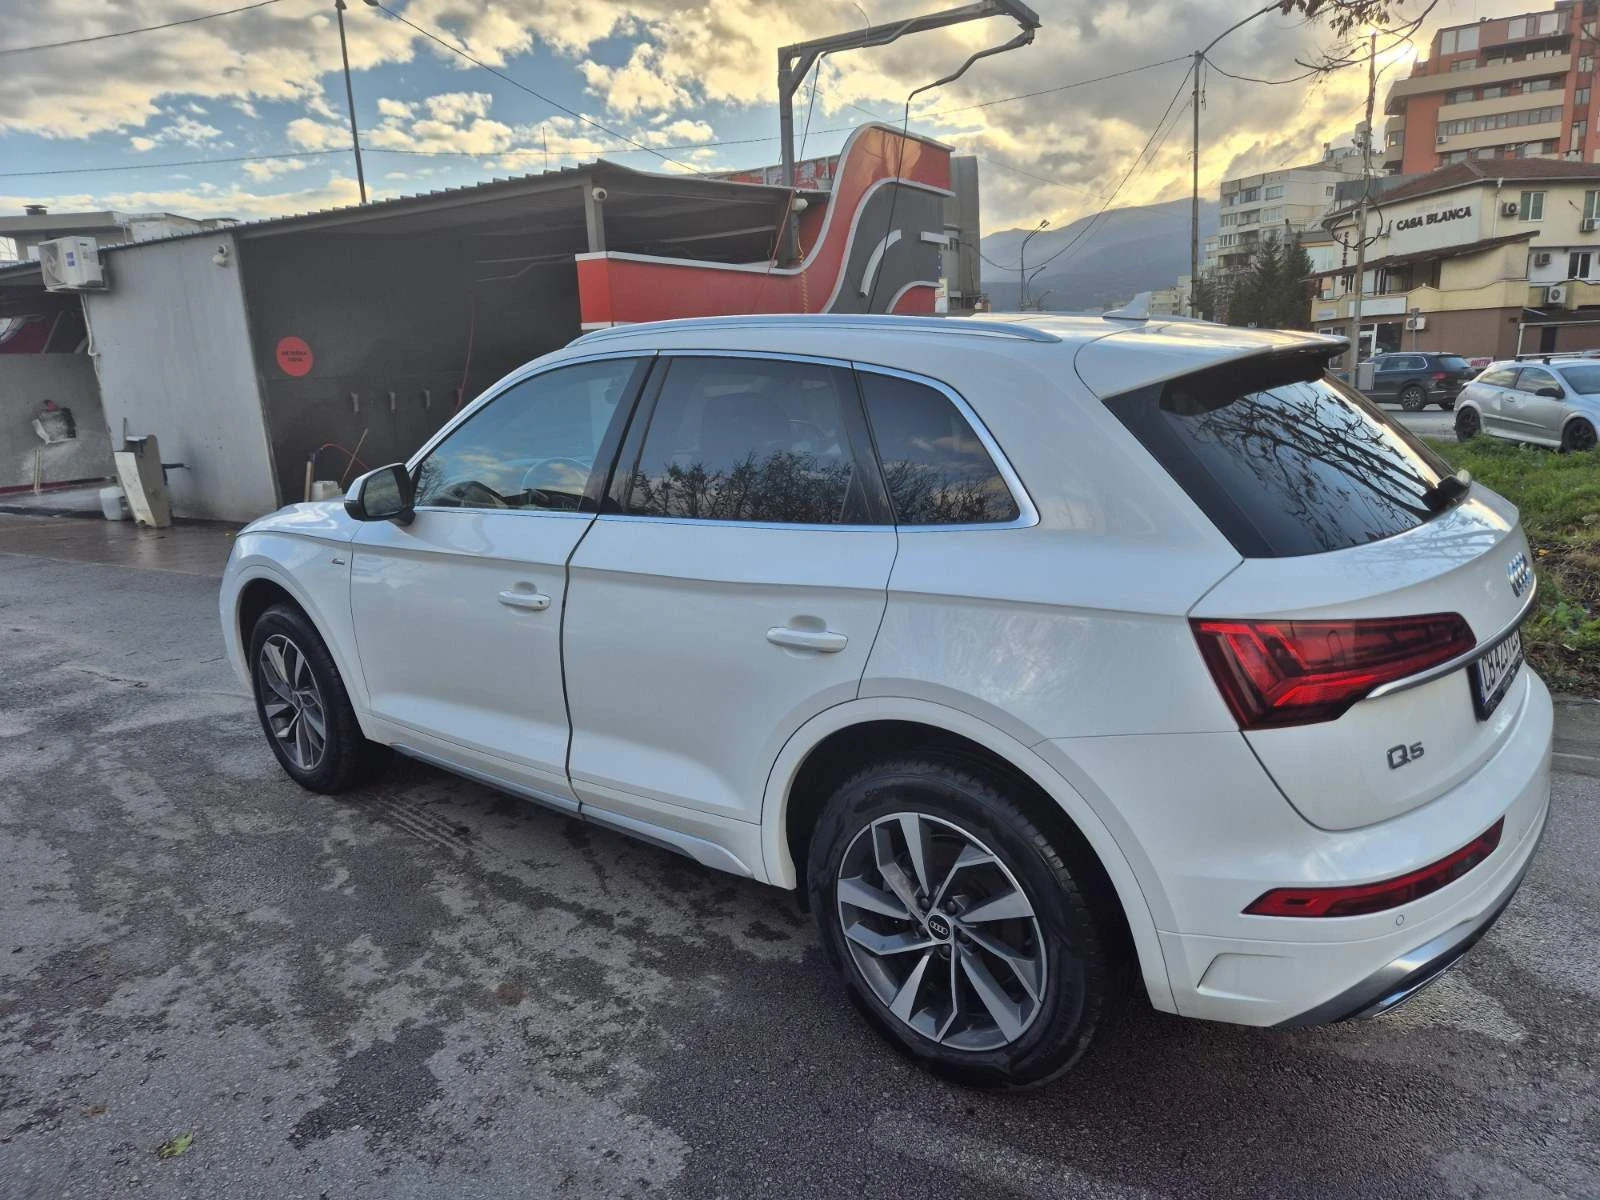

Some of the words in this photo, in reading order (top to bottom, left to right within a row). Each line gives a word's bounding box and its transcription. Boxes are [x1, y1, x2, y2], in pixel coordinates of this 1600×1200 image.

[1397, 216, 1423, 231] CASA
[1426, 206, 1472, 225] BLANCA
[1387, 741, 1425, 769] Q5
